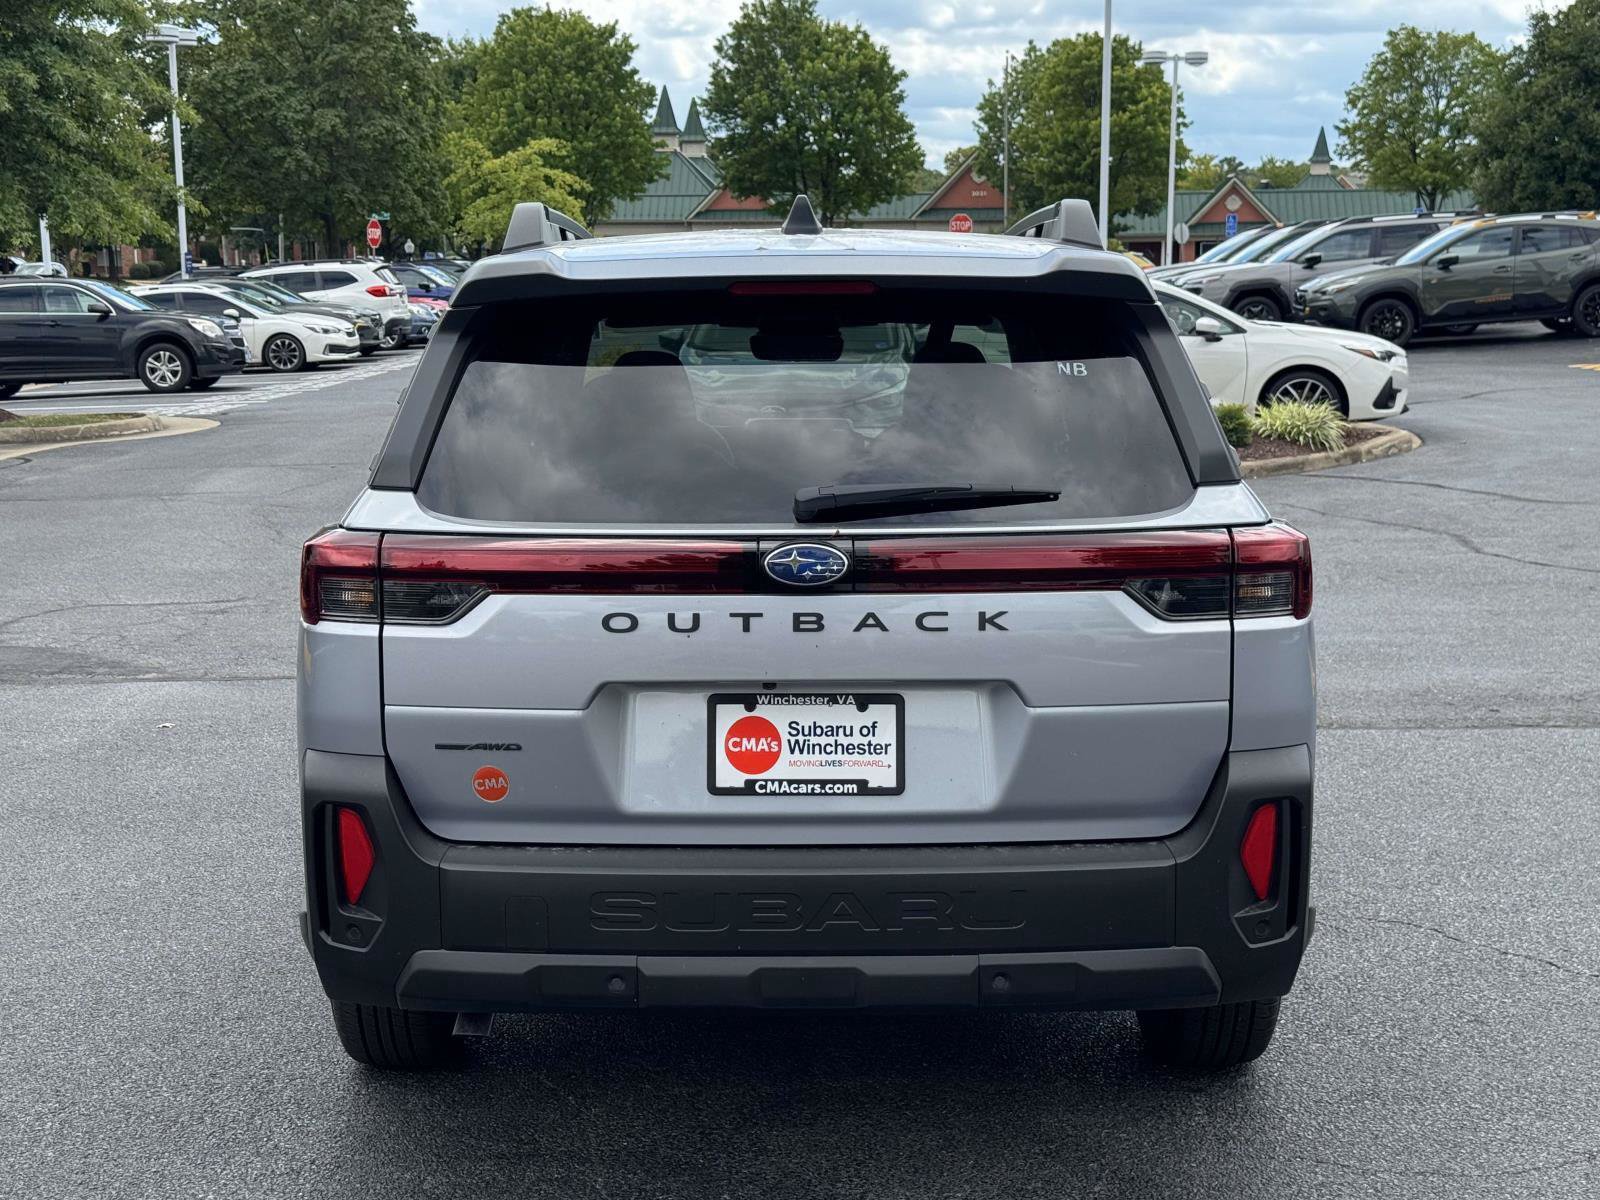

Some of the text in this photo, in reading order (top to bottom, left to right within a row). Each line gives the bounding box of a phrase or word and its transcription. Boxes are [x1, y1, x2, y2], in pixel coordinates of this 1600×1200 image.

[368, 228, 380, 239] STOP
[951, 221, 971, 231] STOP
[1057, 361, 1088, 377] NB
[601, 611, 1009, 634] OUTBACK
[756, 695, 856, 707] Winchester, VA
[787, 721, 878, 738] Subaru of
[727, 737, 779, 752] CMA's
[787, 739, 892, 755] Winchester
[474, 776, 508, 791] CMA
[754, 780, 858, 794] CMAcars.com
[590, 890, 1027, 932] SUBARU
